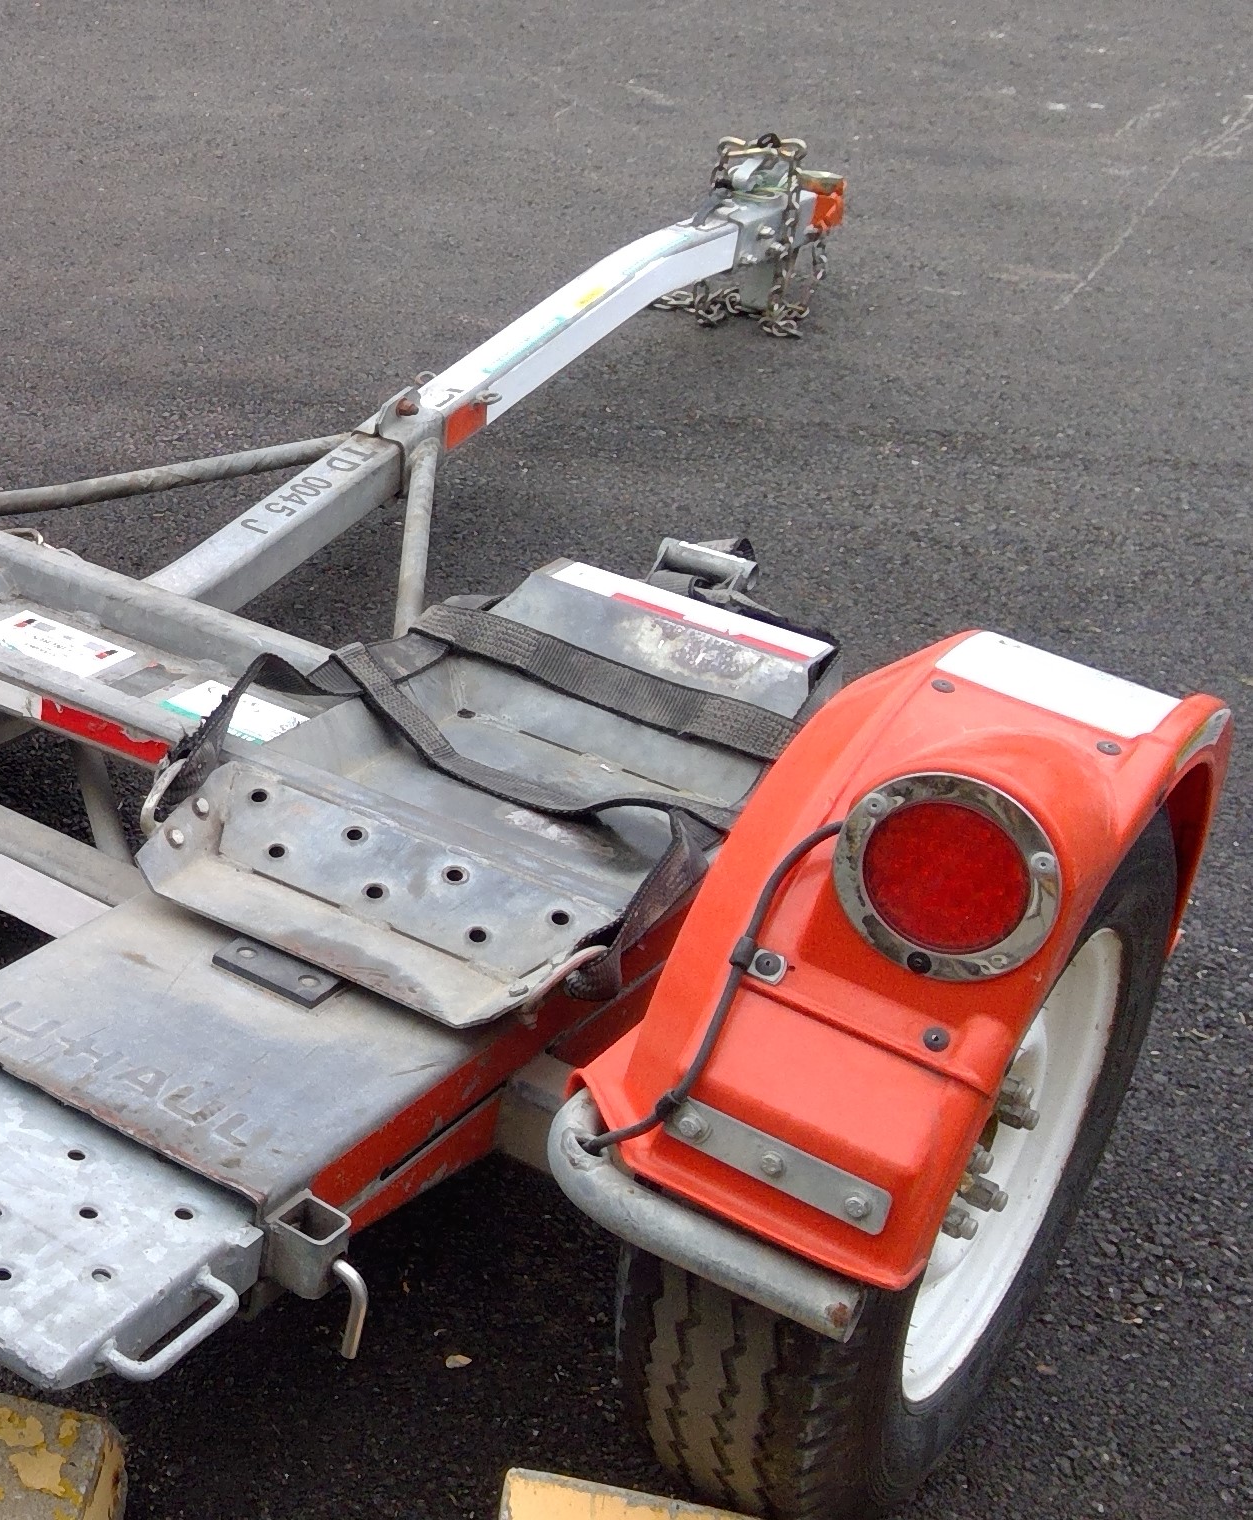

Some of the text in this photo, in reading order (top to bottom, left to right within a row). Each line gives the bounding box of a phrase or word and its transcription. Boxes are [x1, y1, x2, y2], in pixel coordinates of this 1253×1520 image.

[240, 446, 378, 534] TD 0045 J
